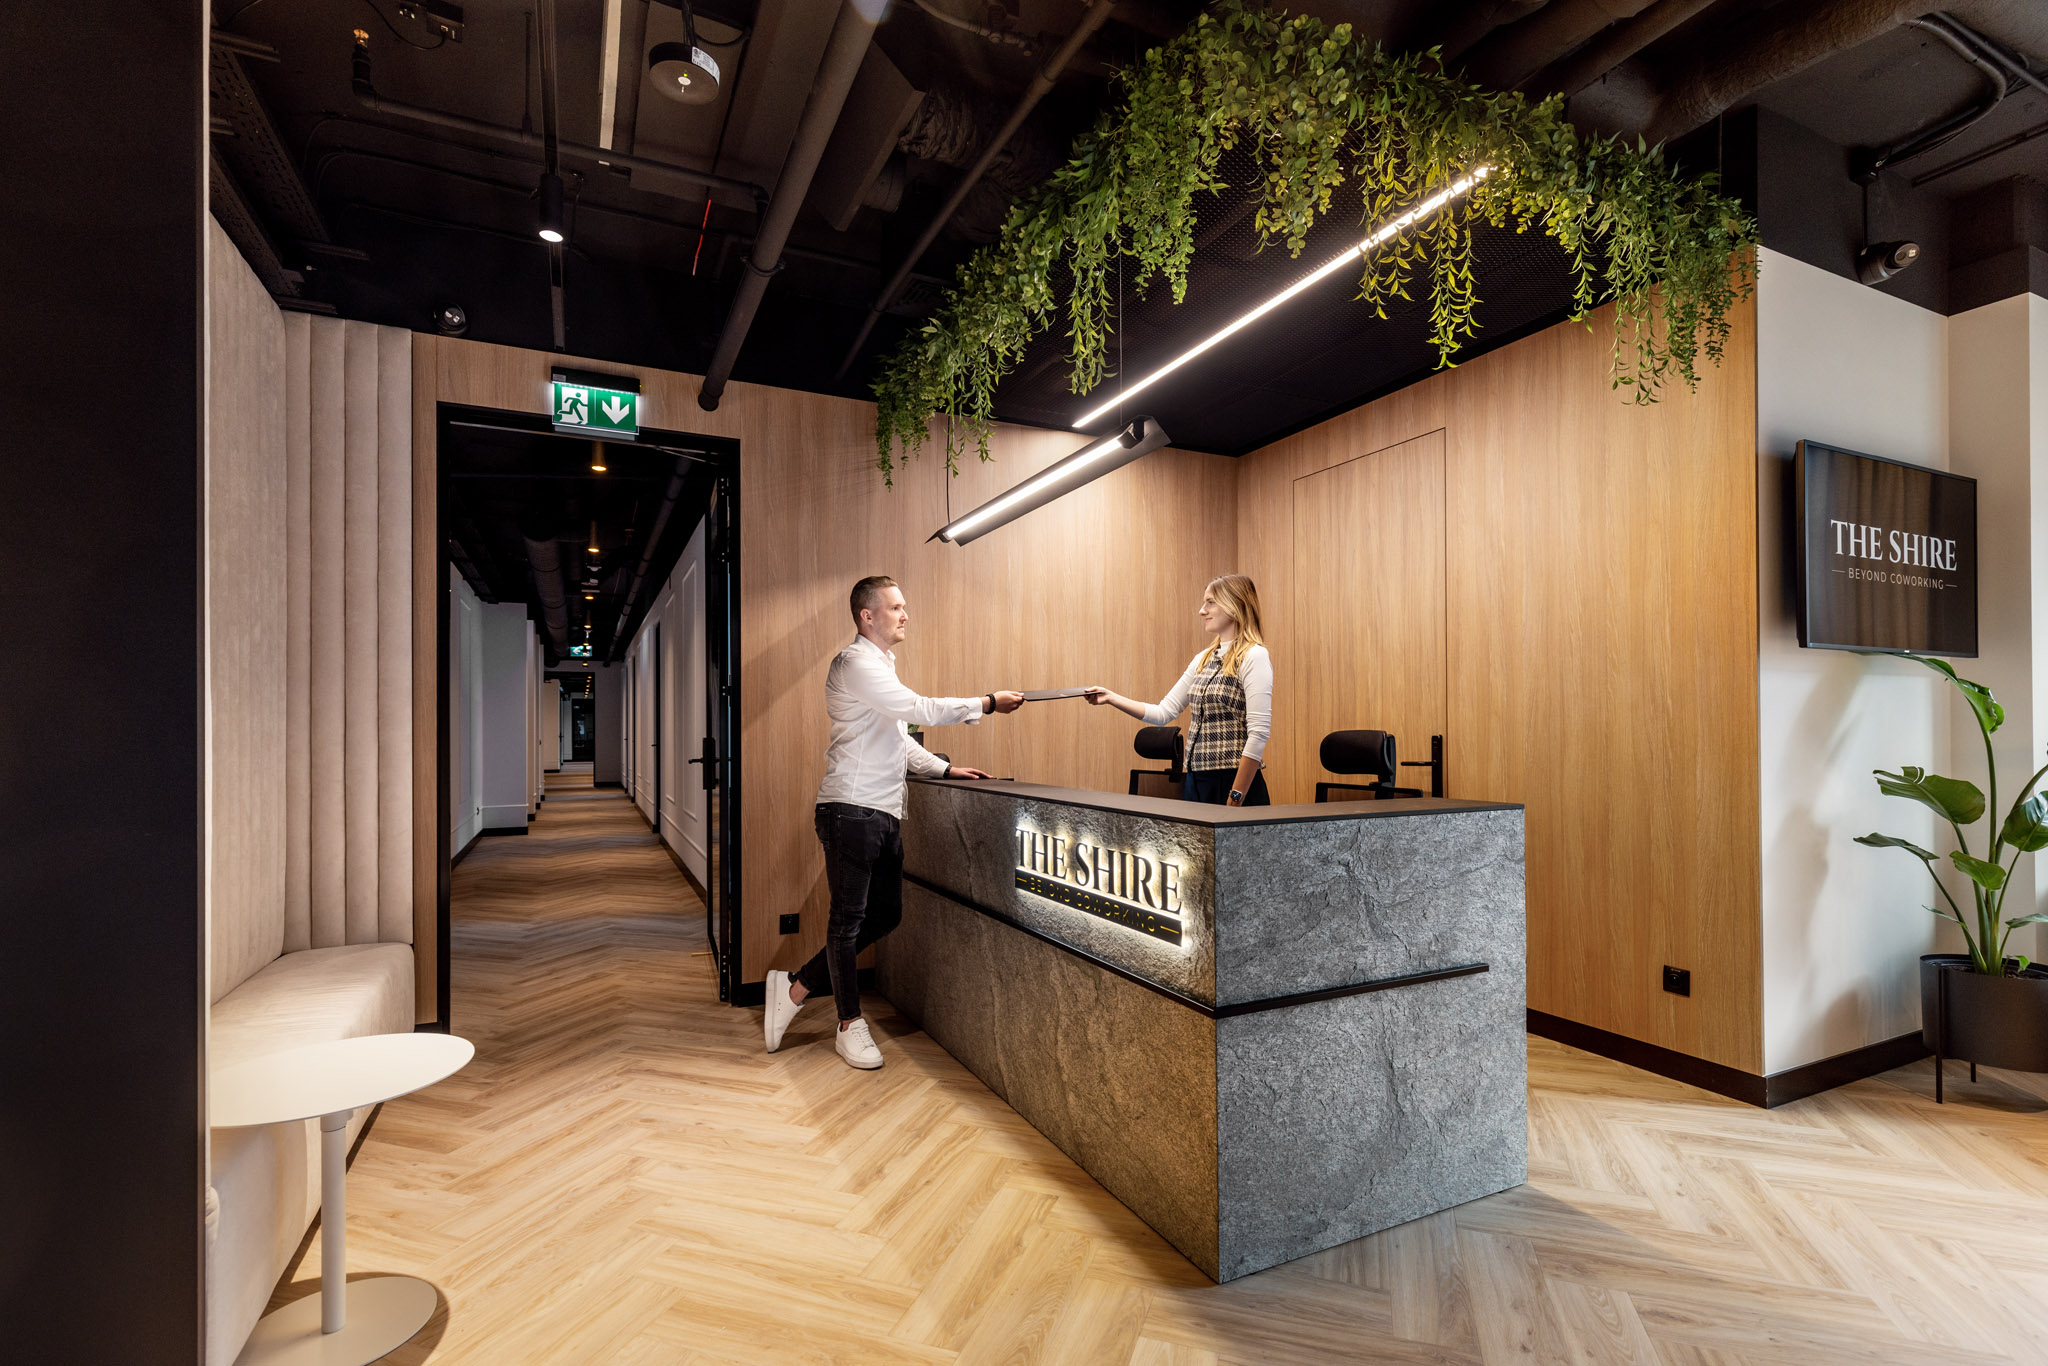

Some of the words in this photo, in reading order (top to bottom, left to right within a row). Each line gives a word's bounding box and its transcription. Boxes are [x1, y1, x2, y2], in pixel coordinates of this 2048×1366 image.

[1830, 519, 1883, 561] THE
[1889, 529, 1958, 572] SHIRE
[1848, 567, 1887, 583] BEYOND
[1890, 573, 1944, 590] COWORKING
[1015, 827, 1068, 880] THE
[1075, 842, 1183, 915] SHIRE
[1029, 876, 1071, 903] BEOND
[1076, 892, 1156, 933] COWORKNG
